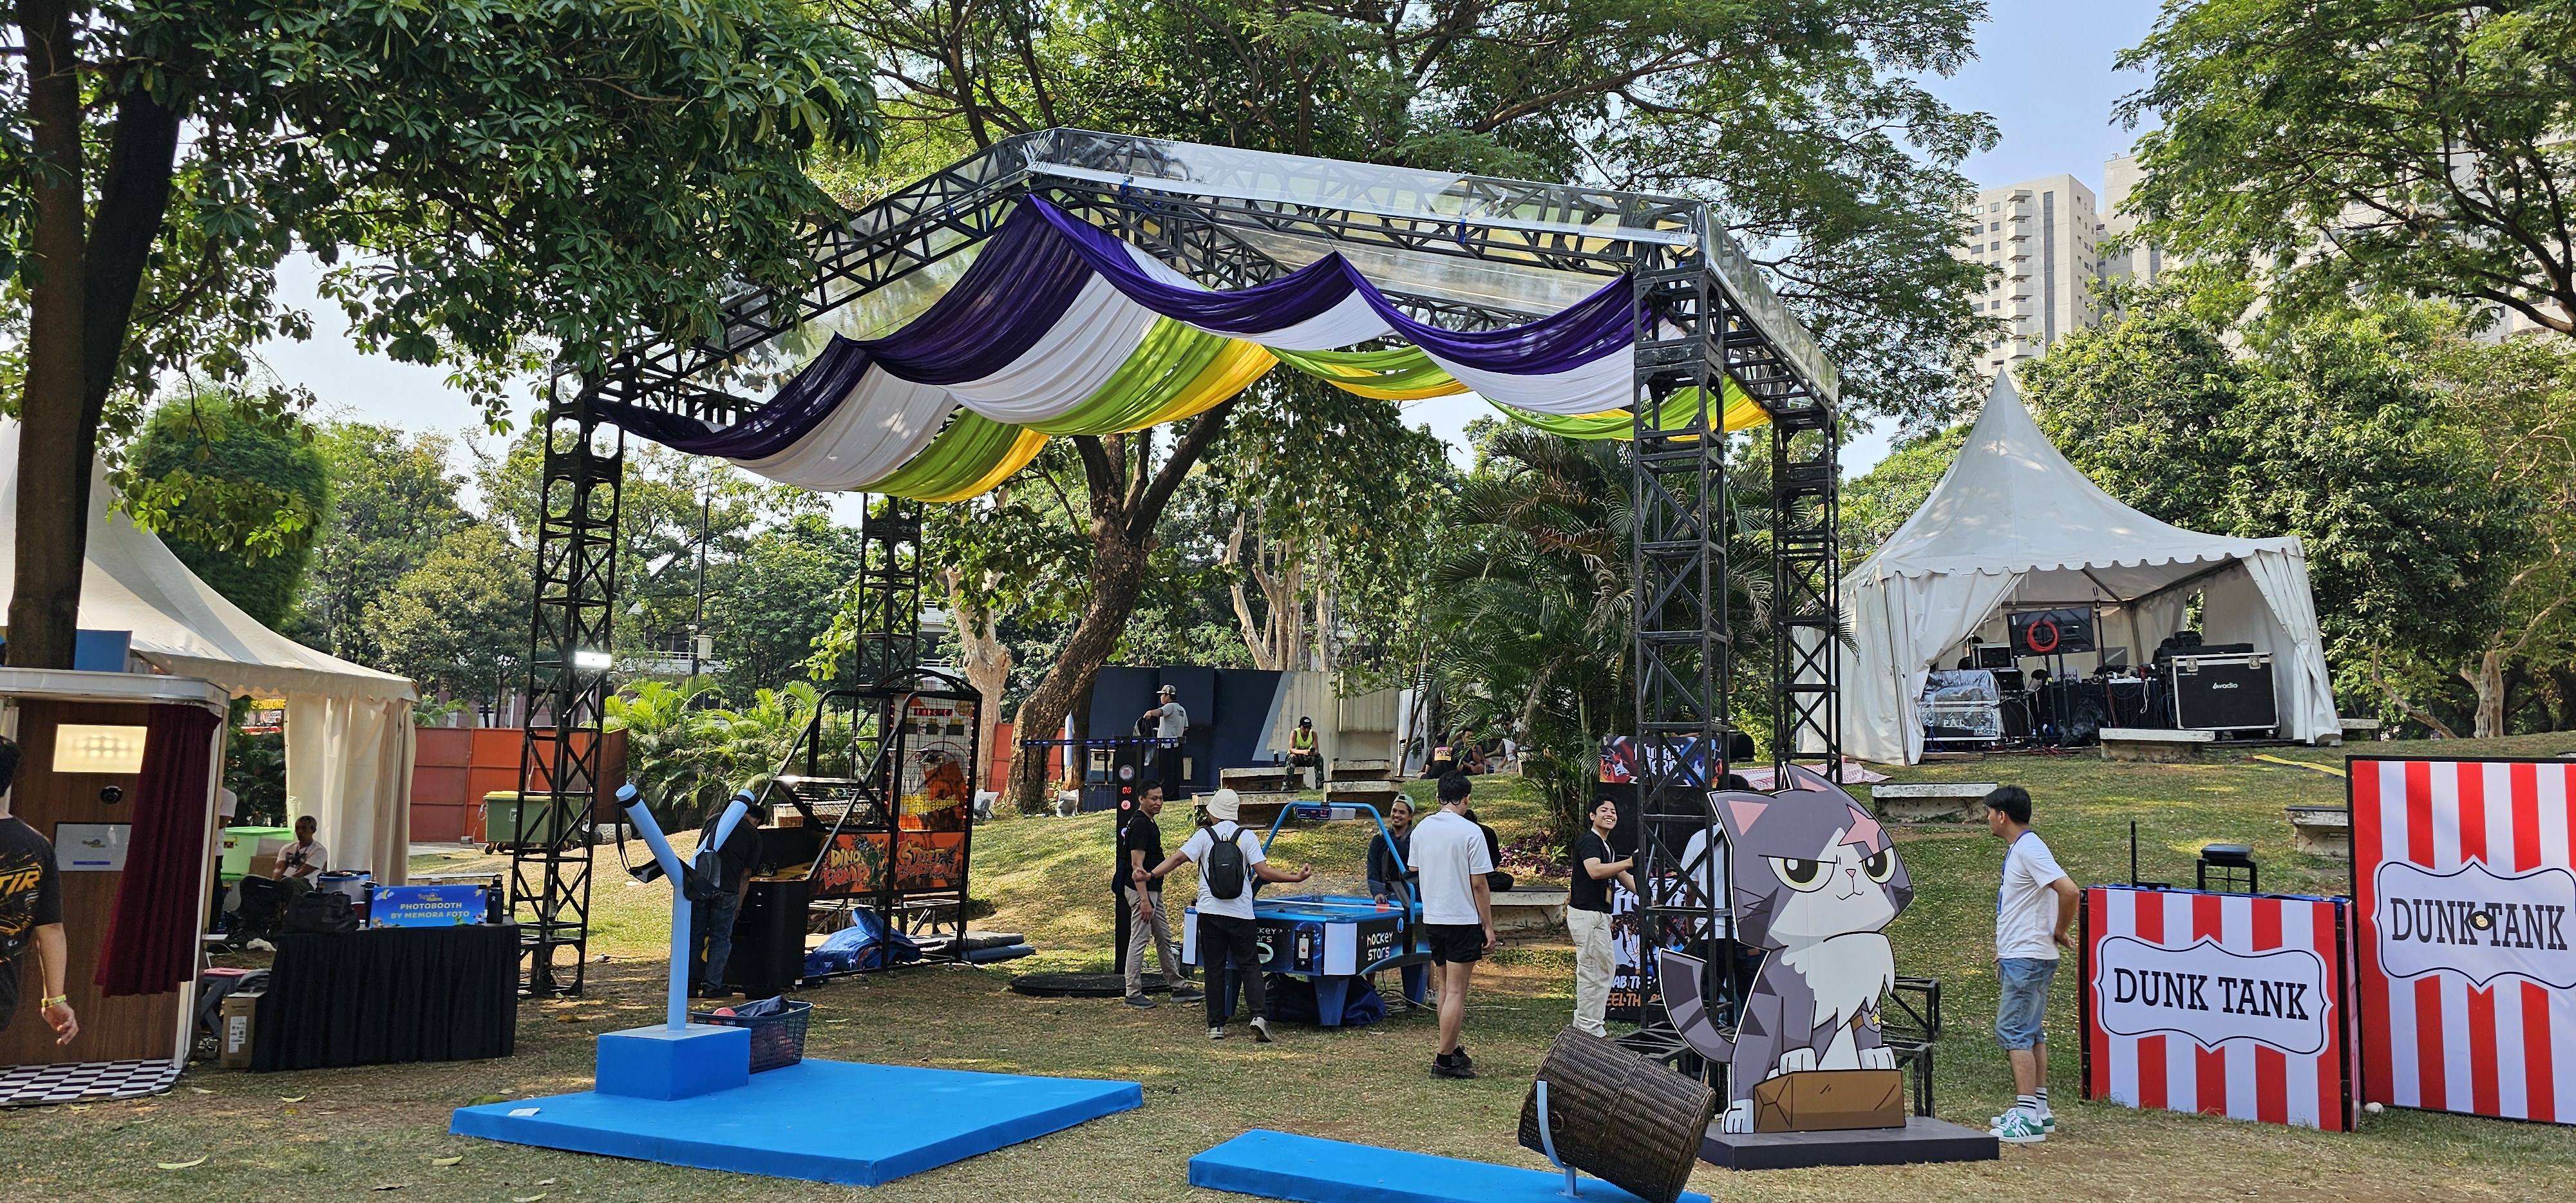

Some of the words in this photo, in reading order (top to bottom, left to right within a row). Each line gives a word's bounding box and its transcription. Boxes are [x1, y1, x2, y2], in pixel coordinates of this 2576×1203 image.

[2390, 897, 2478, 945] DUNK
[2485, 902, 2568, 951] TANK
[2114, 967, 2209, 1011] DUNK
[2217, 976, 2309, 1021] TANK
